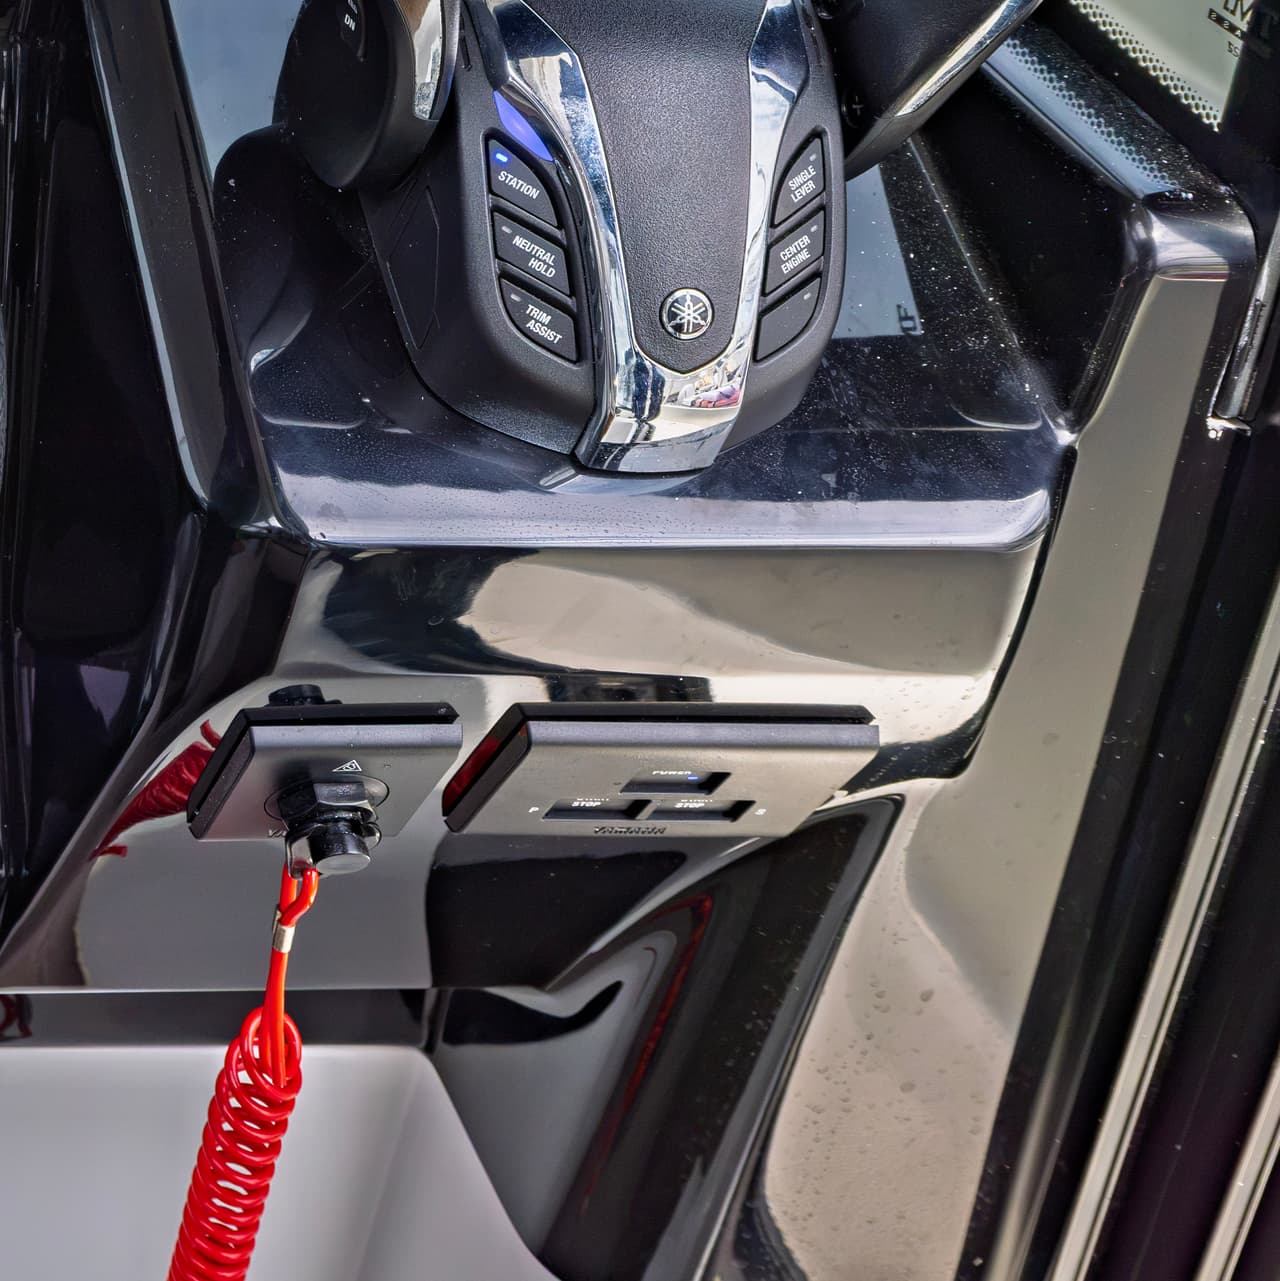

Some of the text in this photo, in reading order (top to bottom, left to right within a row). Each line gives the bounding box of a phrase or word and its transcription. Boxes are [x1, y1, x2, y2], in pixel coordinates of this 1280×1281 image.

[344, 13, 356, 32] DN
[498, 171, 540, 200] STATION
[789, 165, 817, 192] SINGLE
[790, 180, 817, 203] LEVER
[512, 235, 556, 267] NEUTRAL
[780, 235, 811, 262] CENTER
[781, 248, 812, 274] ENGINE
[528, 257, 556, 278] HOLD
[525, 304, 552, 325] TRIM
[526, 319, 563, 345] ASSIST
[592, 826, 667, 835] YAMAHA
